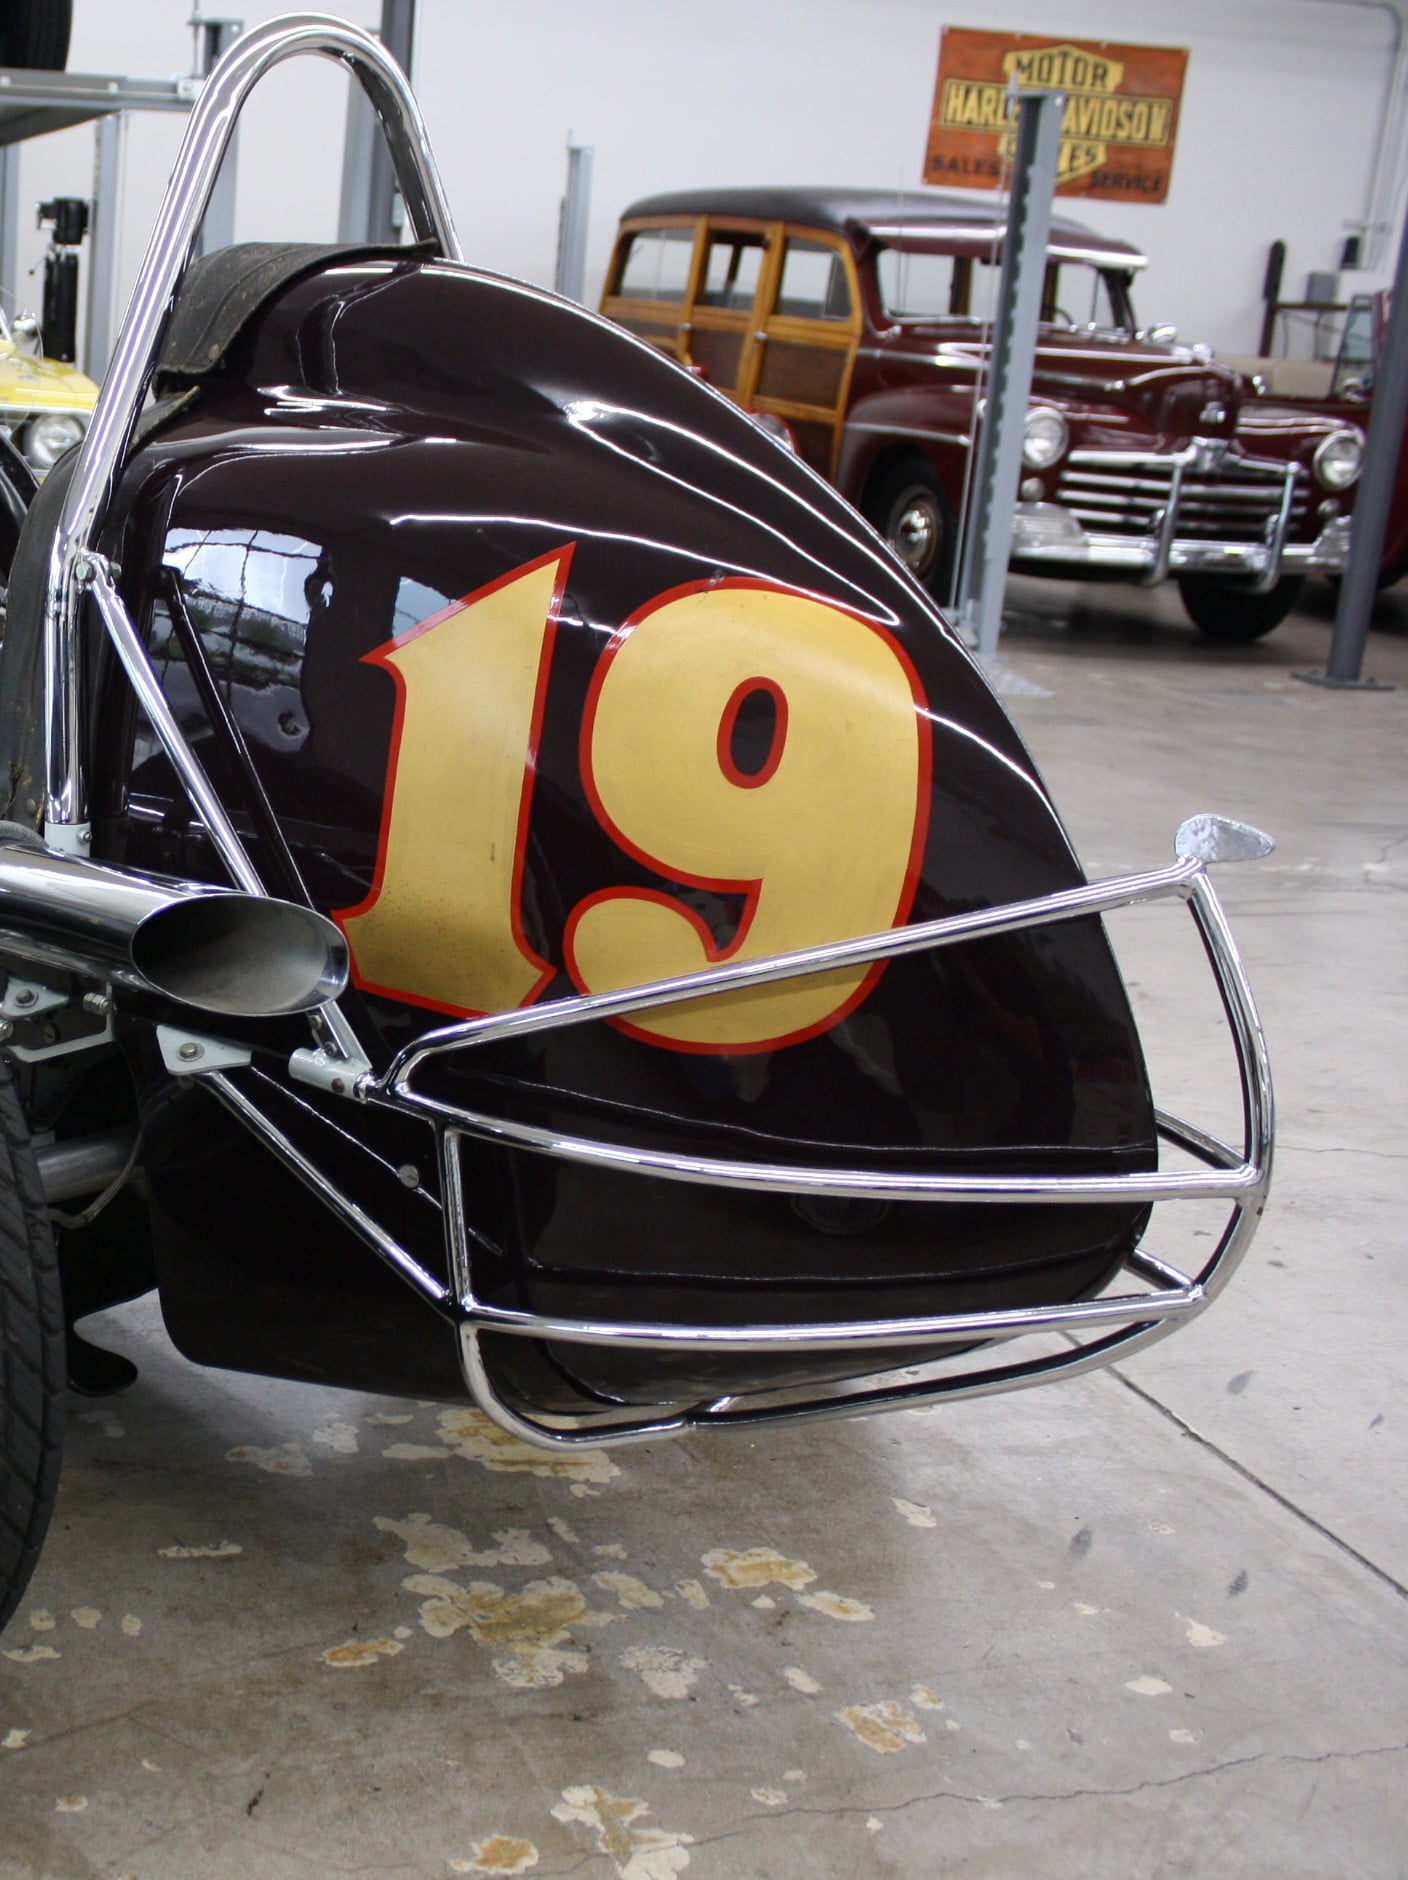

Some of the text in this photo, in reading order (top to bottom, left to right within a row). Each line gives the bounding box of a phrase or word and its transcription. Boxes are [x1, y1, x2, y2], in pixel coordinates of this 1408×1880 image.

[1015, 52, 1110, 89] MOTOR
[932, 154, 1001, 177] SALES
[1090, 171, 1164, 193] SERVICE
[331, 541, 933, 1055] 19
